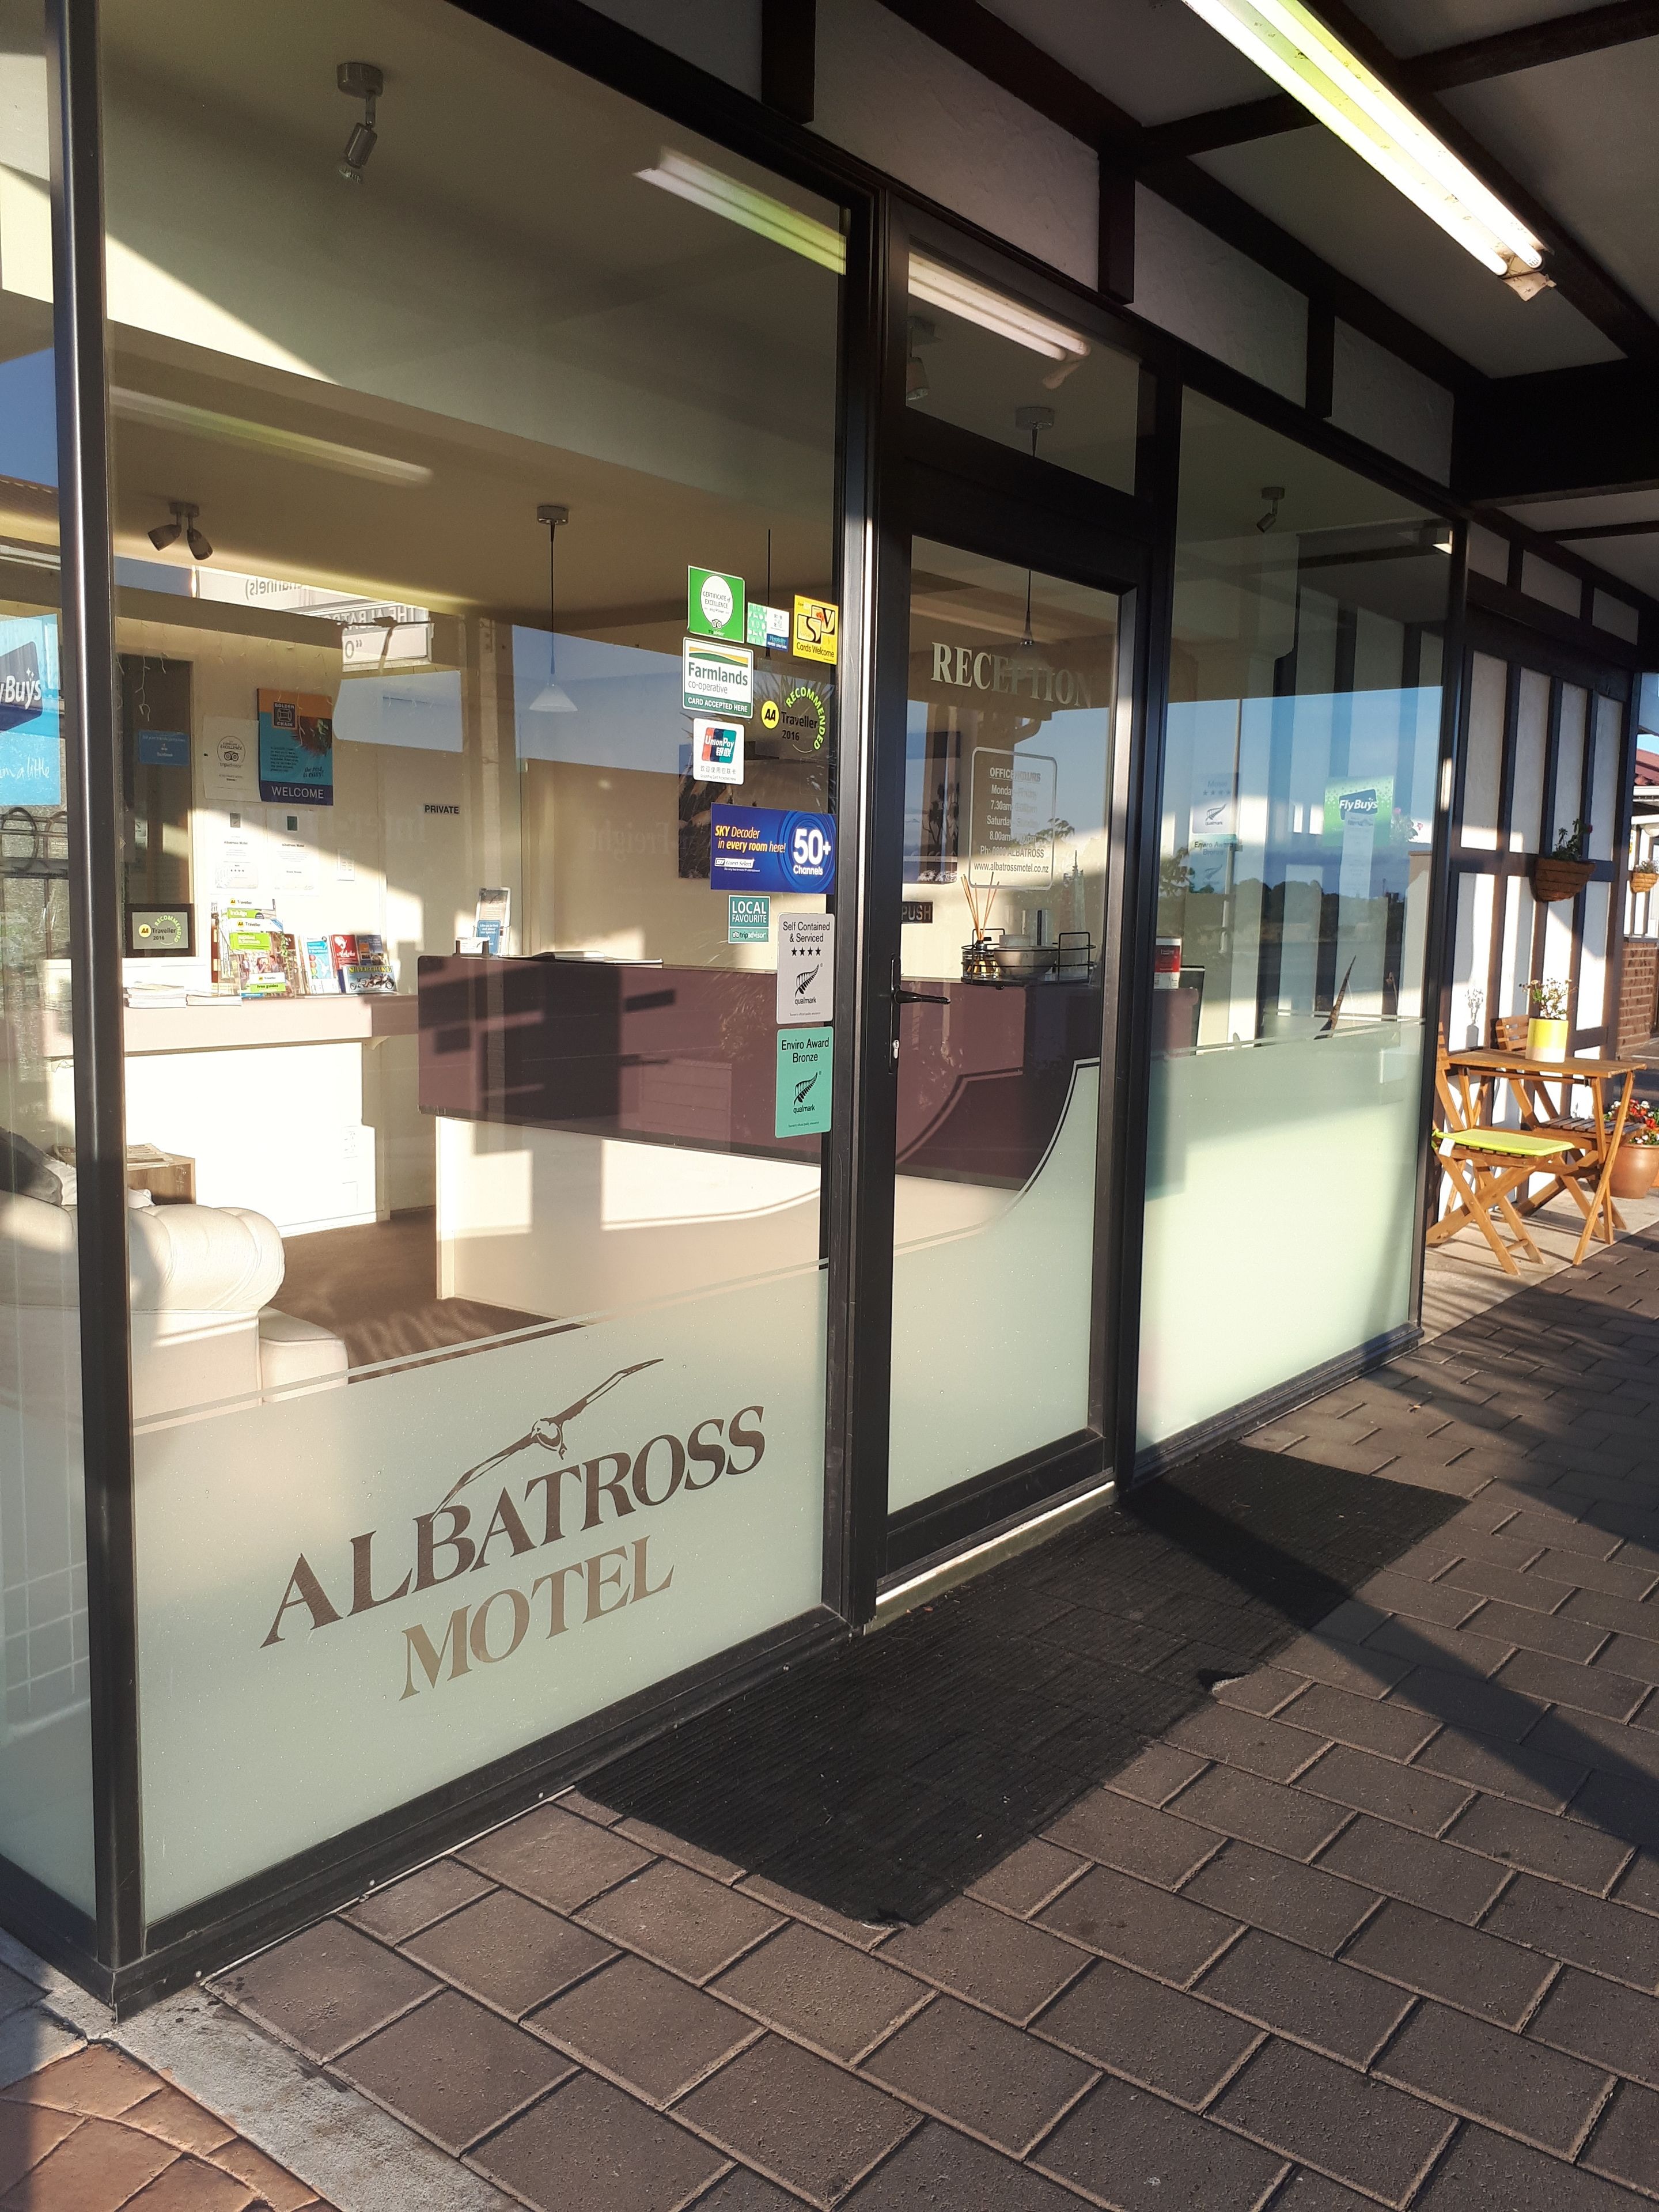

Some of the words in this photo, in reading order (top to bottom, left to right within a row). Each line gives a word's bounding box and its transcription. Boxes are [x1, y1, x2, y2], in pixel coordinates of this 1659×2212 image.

[703, 592, 726, 601] CERTIFICATE
[705, 599, 728, 608] EXCELLENCE
[797, 642, 811, 652] Cards
[812, 645, 834, 658] Welcome
[688, 662, 748, 685] Farmlands
[931, 642, 1092, 709] RECEPTION
[688, 681, 728, 694] co-operative
[688, 698, 703, 706] CARD
[704, 699, 733, 710] ACCEPTED
[734, 703, 748, 712] HERE
[764, 709, 776, 720] AA
[781, 711, 818, 728] Traveller
[785, 686, 826, 750] RECOMMENDED
[782, 730, 800, 741] 2016
[705, 735, 734, 750] UnionPay
[716, 747, 731, 757] 银联
[990, 767, 1014, 779] OFFICE
[272, 786, 324, 798] WELCOME
[425, 804, 460, 815] PRIVATE
[715, 825, 730, 836] SKY
[732, 827, 760, 839] Decoder
[718, 838, 724, 849] in
[726, 840, 748, 853] every
[749, 843, 767, 852] room
[769, 841, 786, 853] here!
[1007, 848, 1044, 858] ALBATROSS
[793, 865, 823, 876] Channels
[974, 862, 1048, 873] www.albatrossmotel.co.nz
[732, 901, 767, 914] LOCAL
[902, 905, 931, 921] PUSH
[732, 914, 767, 923] FAVOURITE
[154, 915, 181, 942] RECOMMENDED
[783, 921, 796, 931] Self
[798, 921, 830, 931] Contained
[740, 931, 765, 940] tripadvisor
[789, 934, 794, 942] &
[796, 933, 824, 942] Serviced
[795, 997, 816, 1006] qualmark
[782, 1039, 804, 1050] Enviro
[806, 1037, 830, 1048] Award
[793, 1052, 818, 1063] Bronze
[793, 1104, 815, 1114] qualmark
[259, 1405, 766, 1649] ALBATROSS
[399, 1534, 675, 1700] MOTEL
